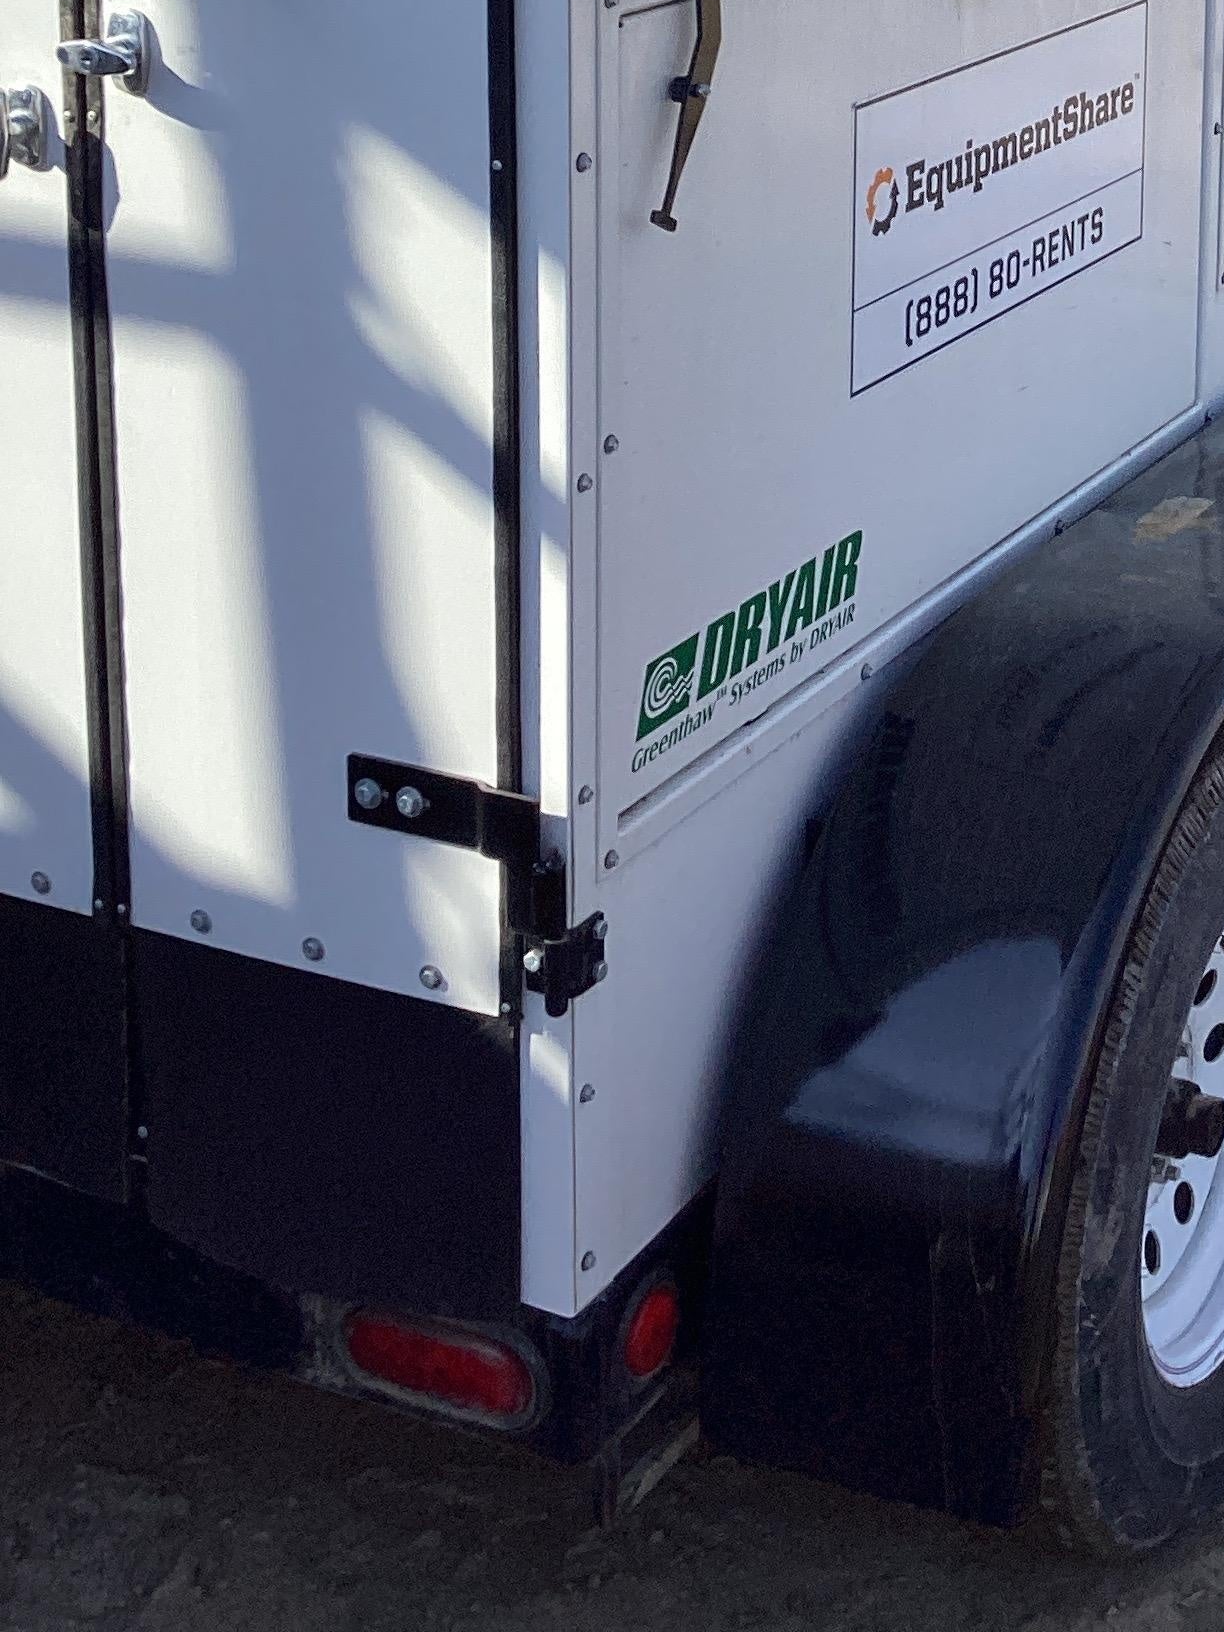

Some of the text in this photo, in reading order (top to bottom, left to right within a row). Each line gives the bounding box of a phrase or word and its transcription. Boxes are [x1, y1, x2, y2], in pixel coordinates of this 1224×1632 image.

[905, 207, 1105, 347] (888) 80-RENTS
[696, 529, 863, 703] DRYAIR
[728, 652, 786, 706] Systems
[790, 638, 808, 663] by
[809, 603, 855, 651] DRYAIR
